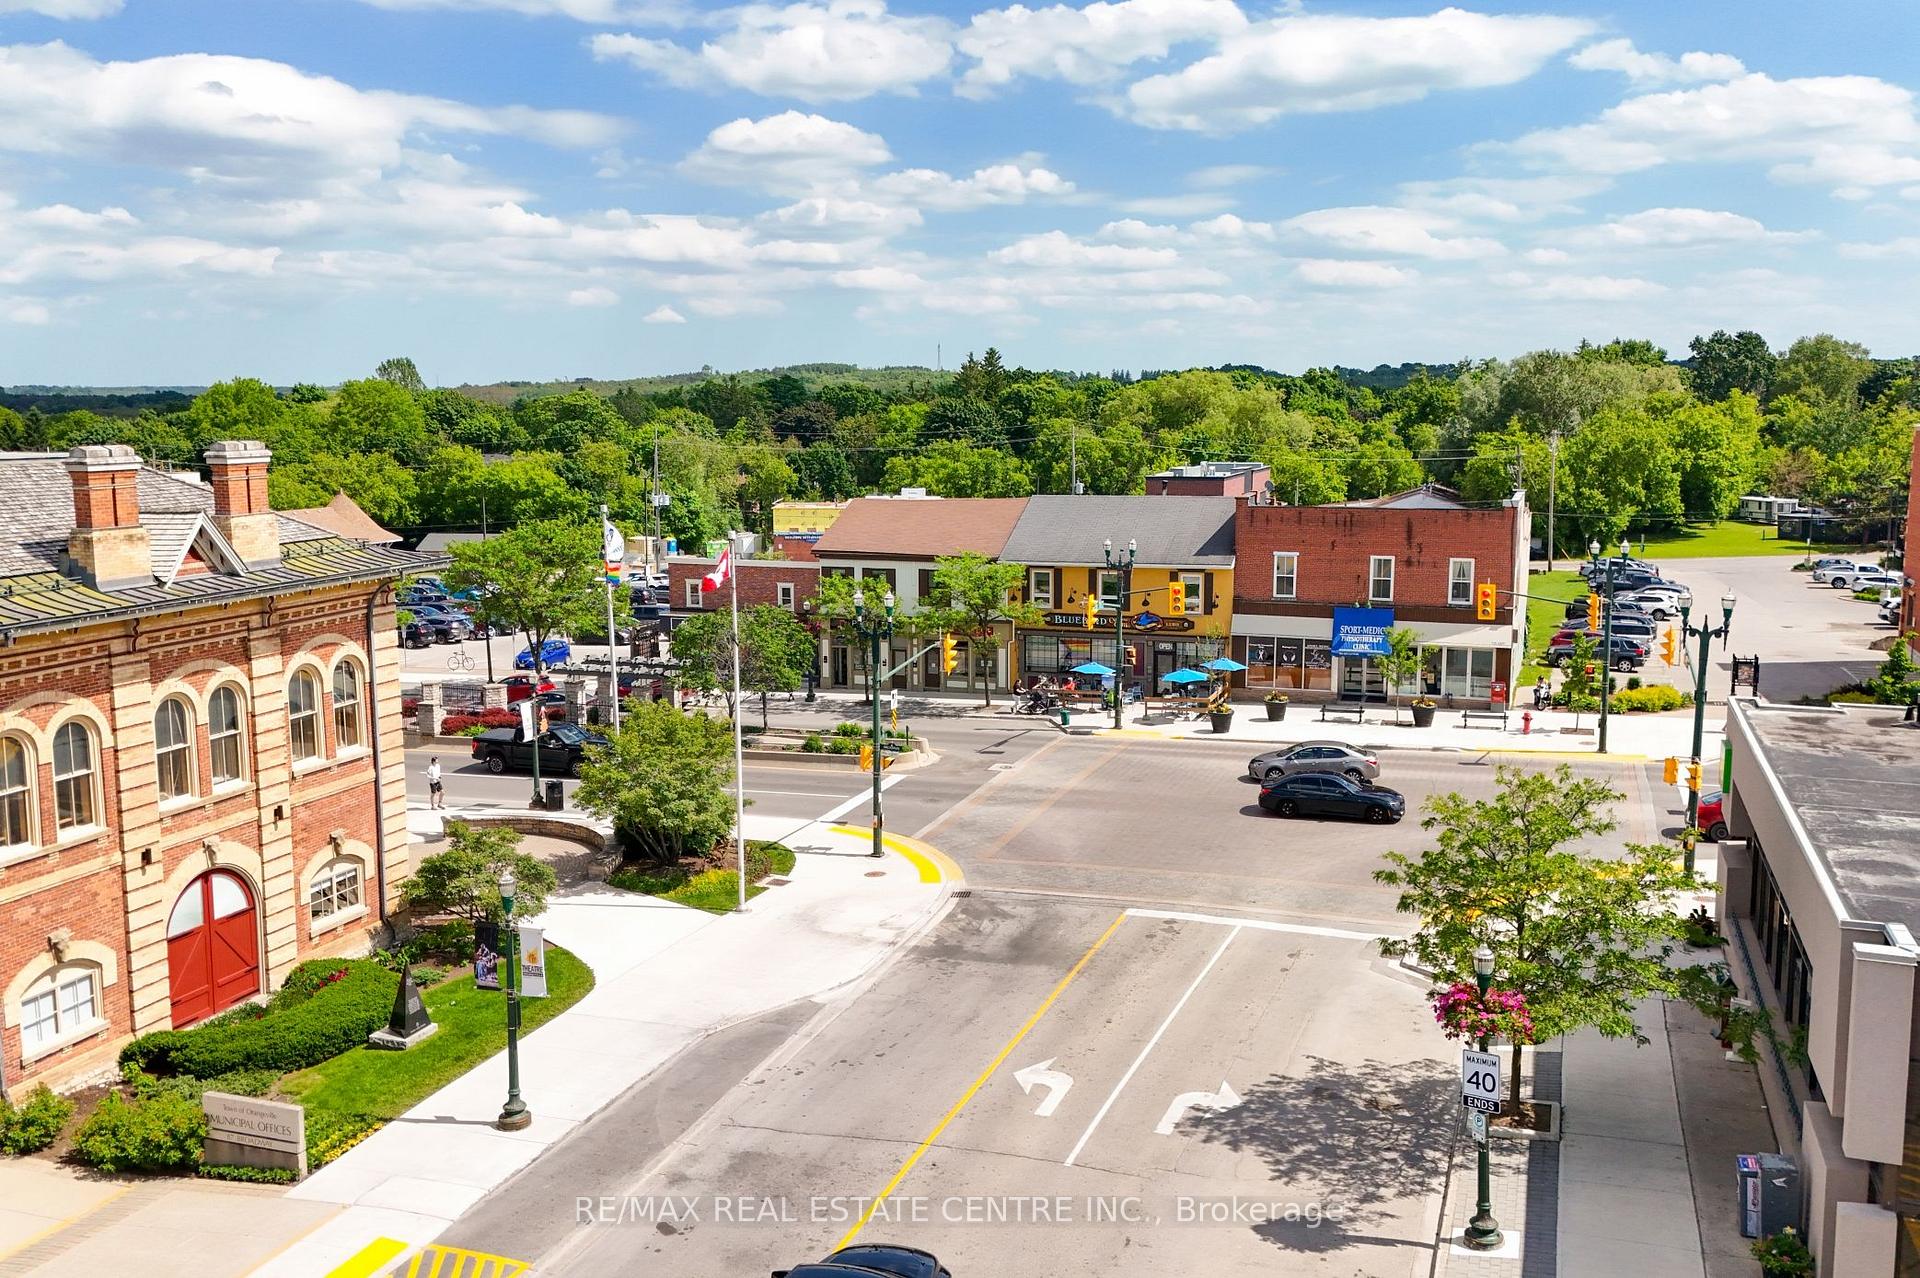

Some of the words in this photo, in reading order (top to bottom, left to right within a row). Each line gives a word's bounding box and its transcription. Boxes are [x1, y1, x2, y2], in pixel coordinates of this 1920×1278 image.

[1055, 615, 1107, 626] BLUEBRD
[1340, 625, 1385, 635] SPORT-MEDIC
[1158, 642, 1173, 650] OPEN
[1466, 1055, 1497, 1067] MAXIMUM
[1467, 1070, 1496, 1093] 40
[1467, 1097, 1495, 1111] ENDS
[222, 1104, 238, 1113] Town
[246, 1108, 277, 1120] Orangeville
[210, 1114, 255, 1130] MUNICIPAL
[257, 1121, 292, 1137] OFFICES
